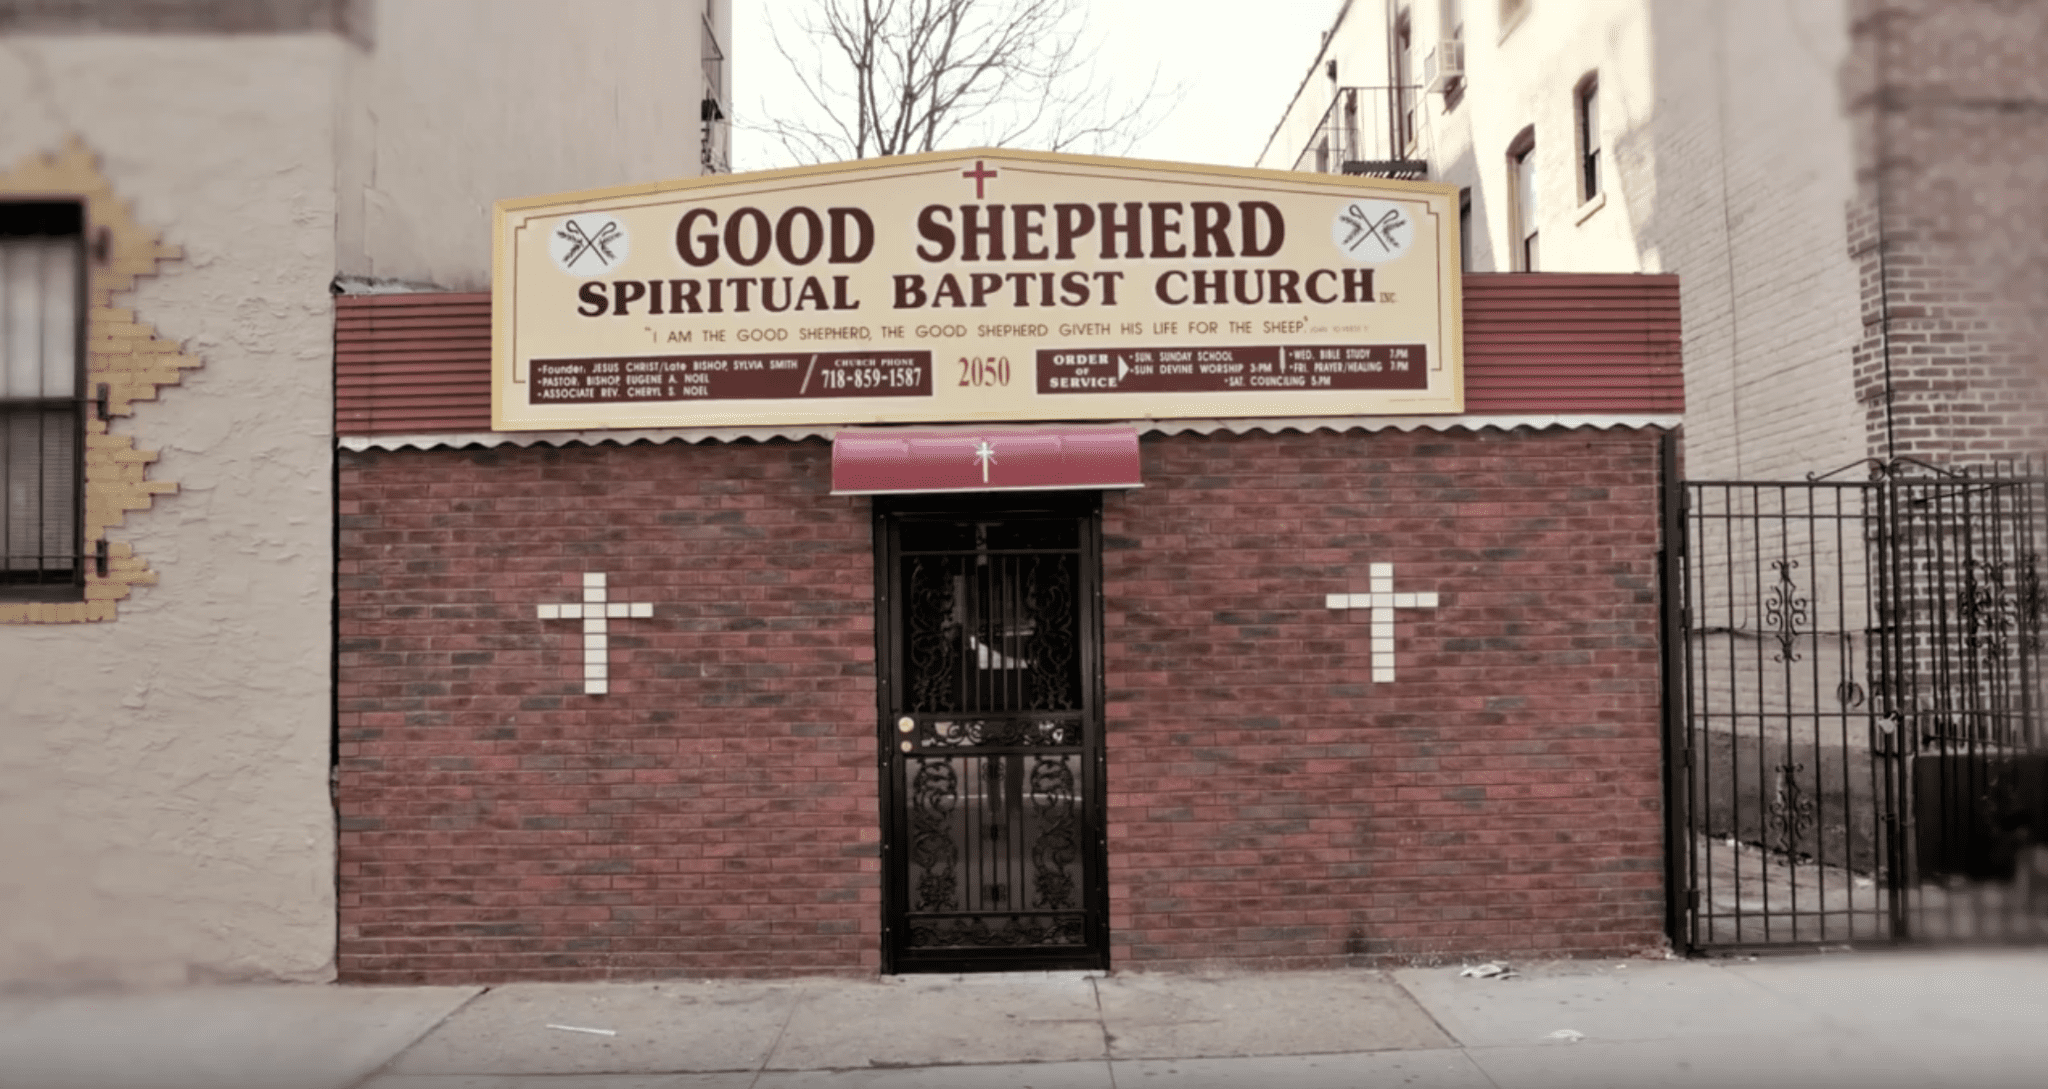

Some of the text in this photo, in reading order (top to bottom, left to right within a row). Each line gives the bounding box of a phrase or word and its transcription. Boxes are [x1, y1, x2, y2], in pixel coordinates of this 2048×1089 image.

[675, 200, 1286, 267] GOOD SHEPHERD
[577, 275, 860, 317] SPIRITUAL
[893, 270, 1124, 310] BAPTIST
[1155, 268, 1375, 305] CHURCH
[667, 330, 692, 343] AM
[702, 329, 726, 342] THE
[736, 328, 788, 342] GOOD
[799, 326, 872, 342] SHEPHERD,
[881, 325, 904, 338] THE
[915, 324, 967, 338] GOOD
[977, 323, 1049, 337] SHEPHERD
[1058, 322, 1111, 337] GIVETH
[1119, 322, 1143, 335] HIS
[1153, 321, 1178, 335] LIFE
[1188, 321, 1218, 334] FOR
[1229, 321, 1252, 334] THE
[1053, 354, 1109, 366] ORDER
[1159, 351, 1192, 362] SUNDAY
[1197, 351, 1233, 362] SCHOOL
[1320, 349, 1341, 360] BIBLE
[1346, 348, 1371, 360] STUDY
[592, 362, 620, 373] JESUS
[733, 360, 764, 371] SYLVIA
[770, 359, 798, 370] SMITH
[834, 358, 915, 367] CHURCH PHONE
[1159, 363, 1193, 374] DEVINE
[1199, 363, 1244, 374] WORSHIP
[1314, 361, 1383, 373] PRAYER/HEALING
[957, 356, 1011, 387] 2050
[1075, 367, 1090, 376] OF
[626, 374, 662, 385] EUGENE
[668, 374, 678, 384] A.
[684, 373, 710, 384] NOEL
[821, 367, 922, 389] 718-859-1587
[1050, 376, 1118, 388] SERVICE
[542, 387, 595, 399] ASSOCIATE
[601, 386, 620, 397] REV.
[627, 386, 662, 397] CHERYL
[683, 386, 708, 396] NOEL
